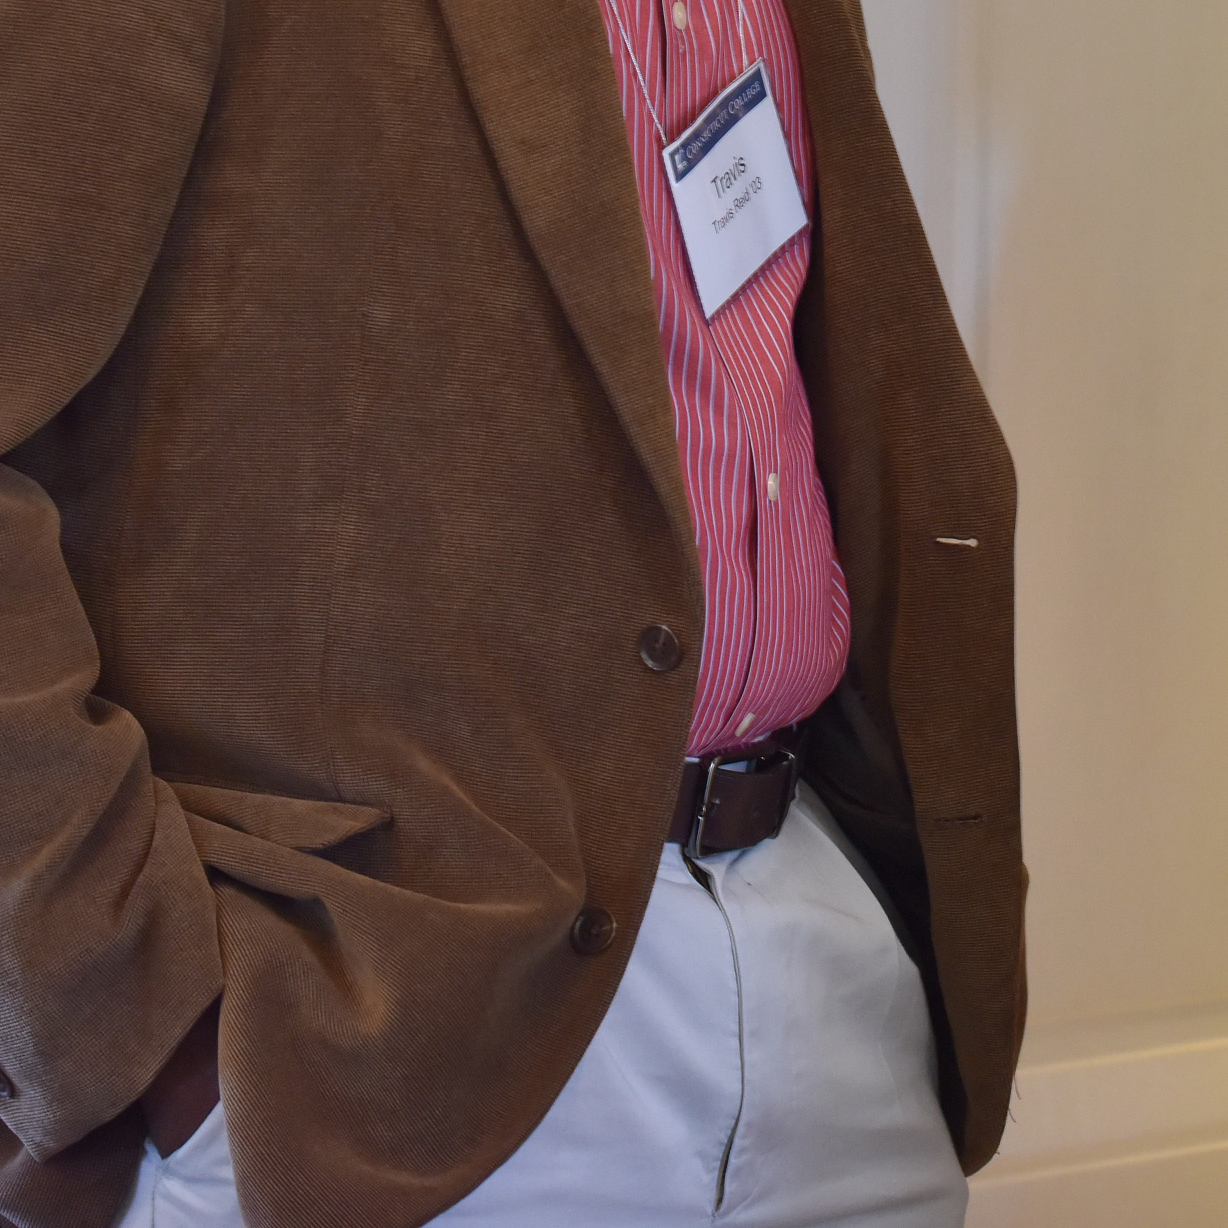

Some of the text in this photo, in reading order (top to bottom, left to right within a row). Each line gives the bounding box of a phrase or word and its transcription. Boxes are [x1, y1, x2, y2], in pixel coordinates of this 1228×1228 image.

[686, 81, 760, 159] CONNECTICUT COLLEGE
[711, 156, 747, 198] Travis
[712, 206, 735, 234] Travis
[733, 189, 750, 214] Reid
